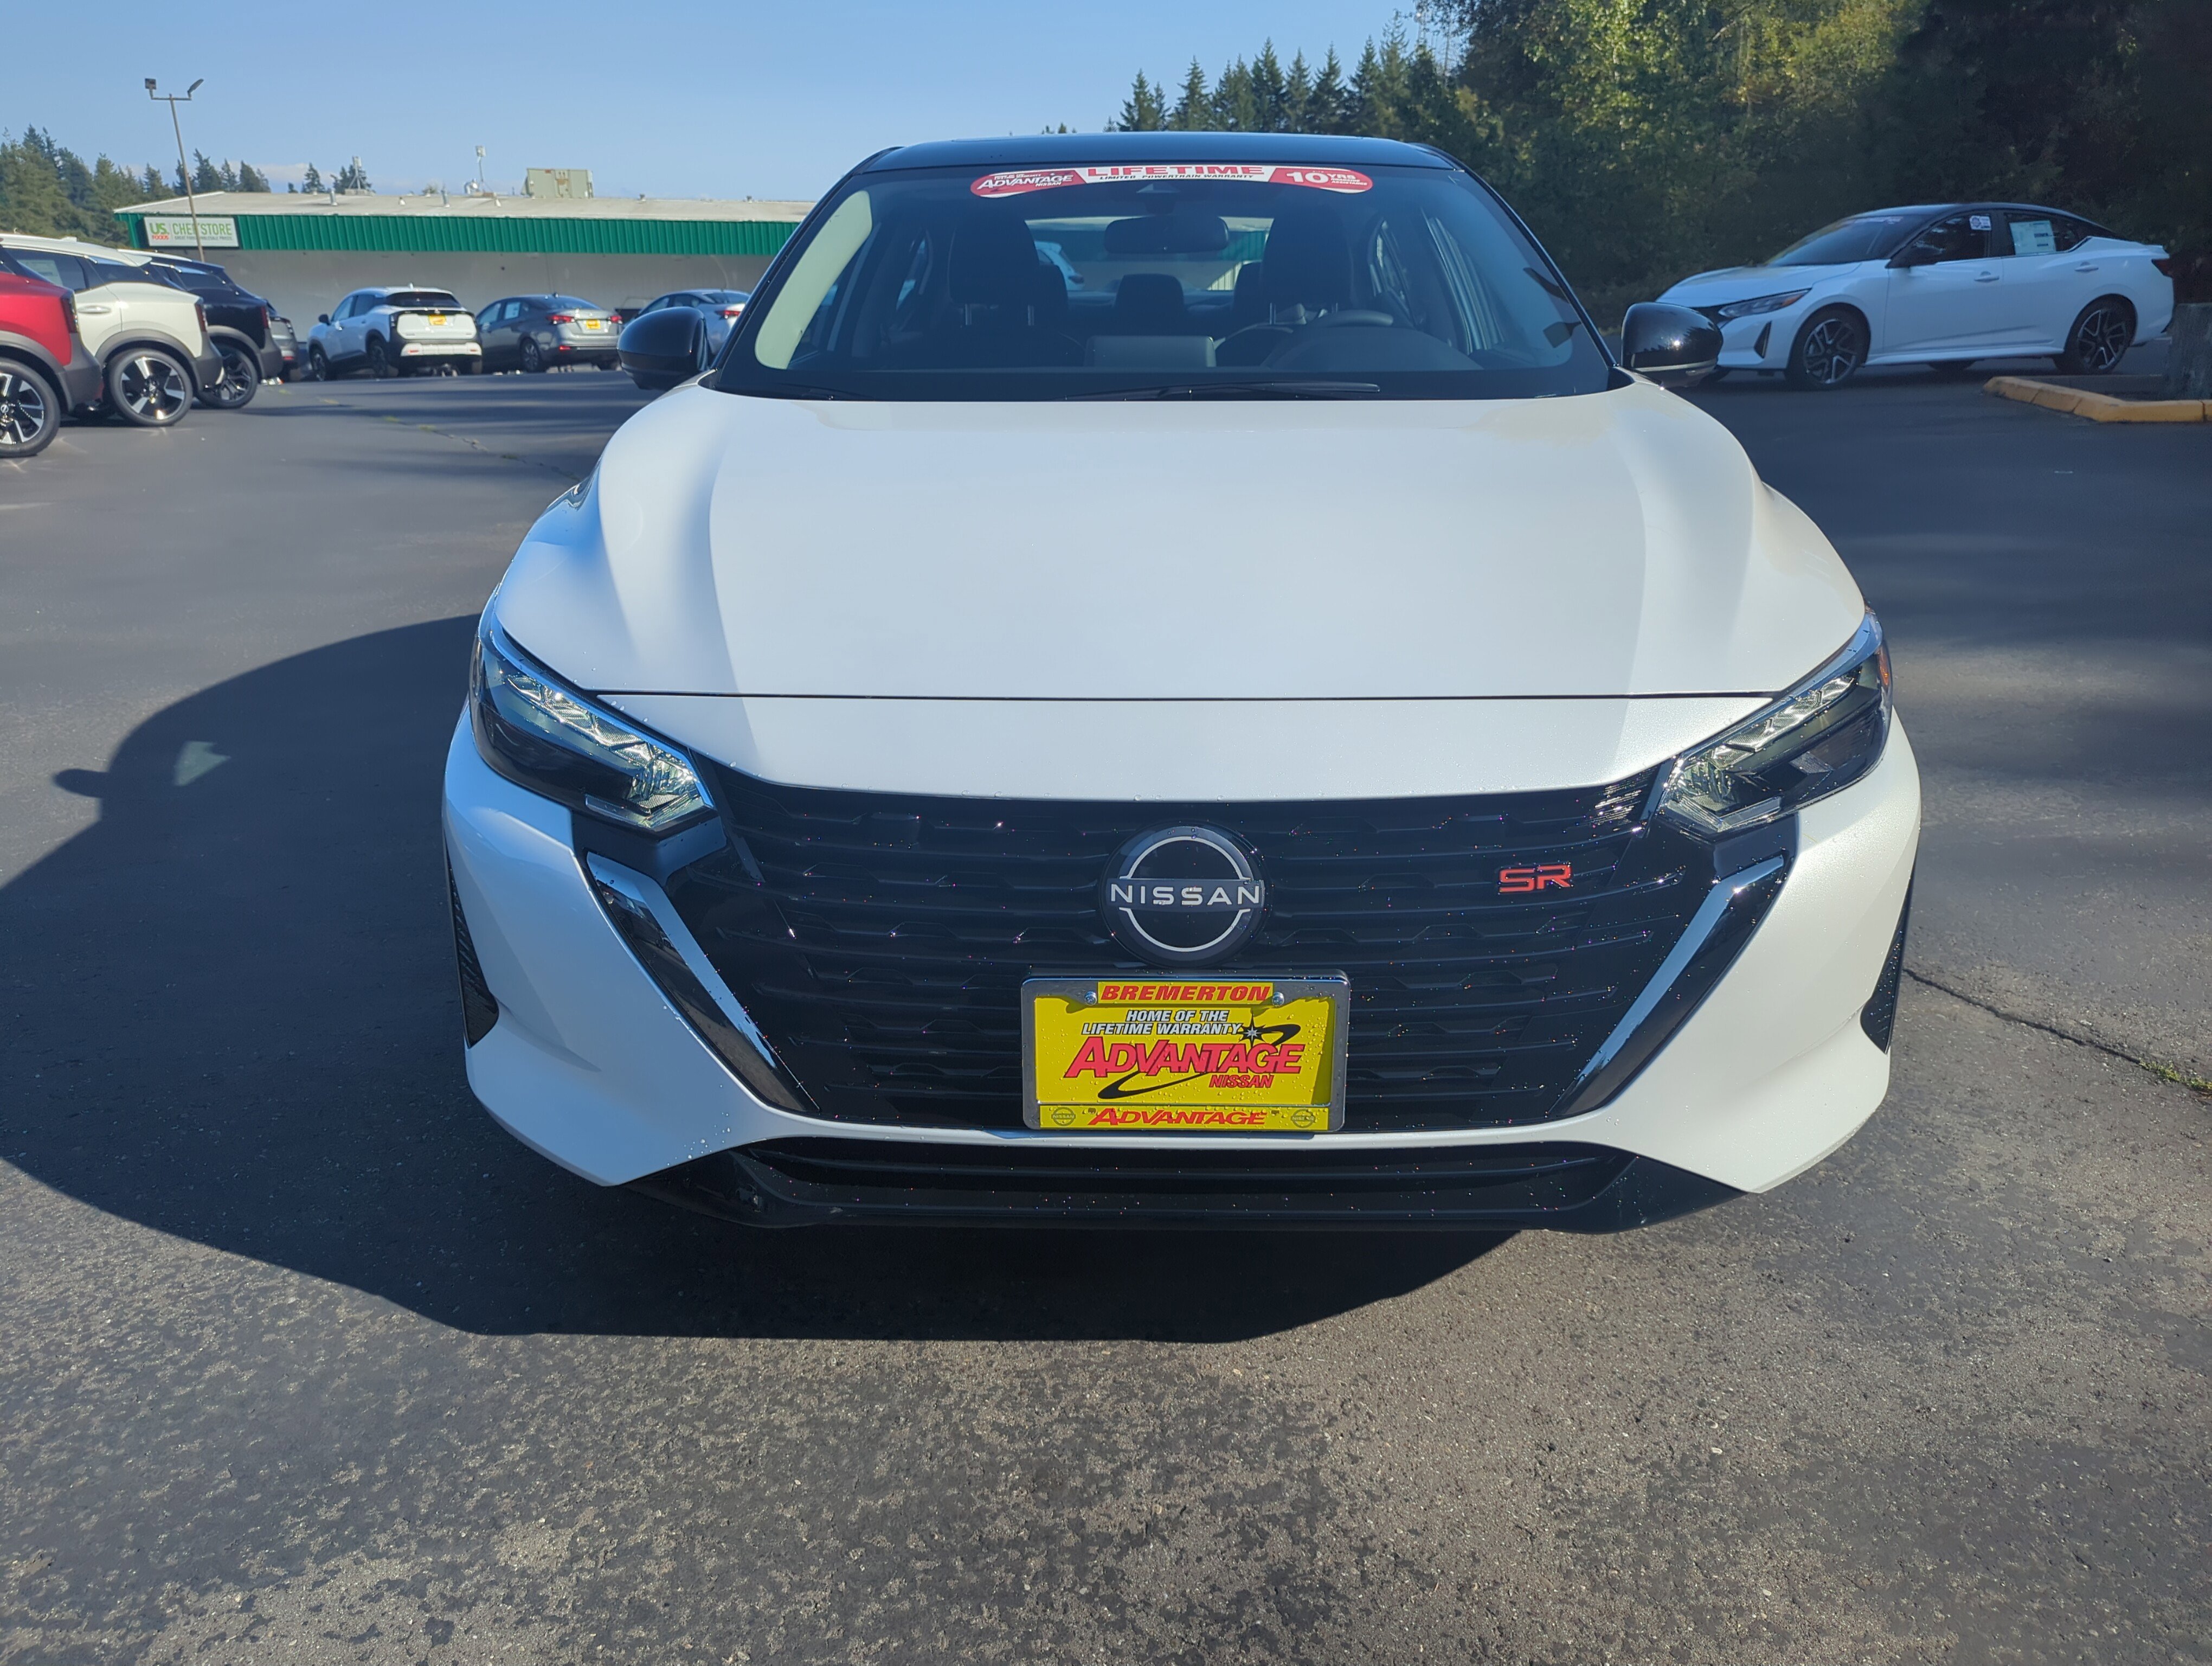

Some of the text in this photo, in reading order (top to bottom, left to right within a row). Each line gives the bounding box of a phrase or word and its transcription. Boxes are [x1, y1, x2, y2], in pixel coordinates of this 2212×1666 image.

[1088, 166, 1264, 176] LIFETIME
[1287, 171, 1328, 183] 10
[976, 175, 1074, 190] ADVANTAGE
[1500, 864, 1571, 892] SR
[1111, 883, 1259, 906] NISSAN
[1101, 985, 1271, 1001] BREMERTON
[1126, 1009, 1230, 1022] HOME OF THE
[1081, 1022, 1243, 1035] LIFETIME WARRANTY
[1063, 1036, 1306, 1078] ADVANTAGE
[1208, 1074, 1274, 1088] NISSAN
[1088, 1108, 1268, 1126] ADVANTAGE
